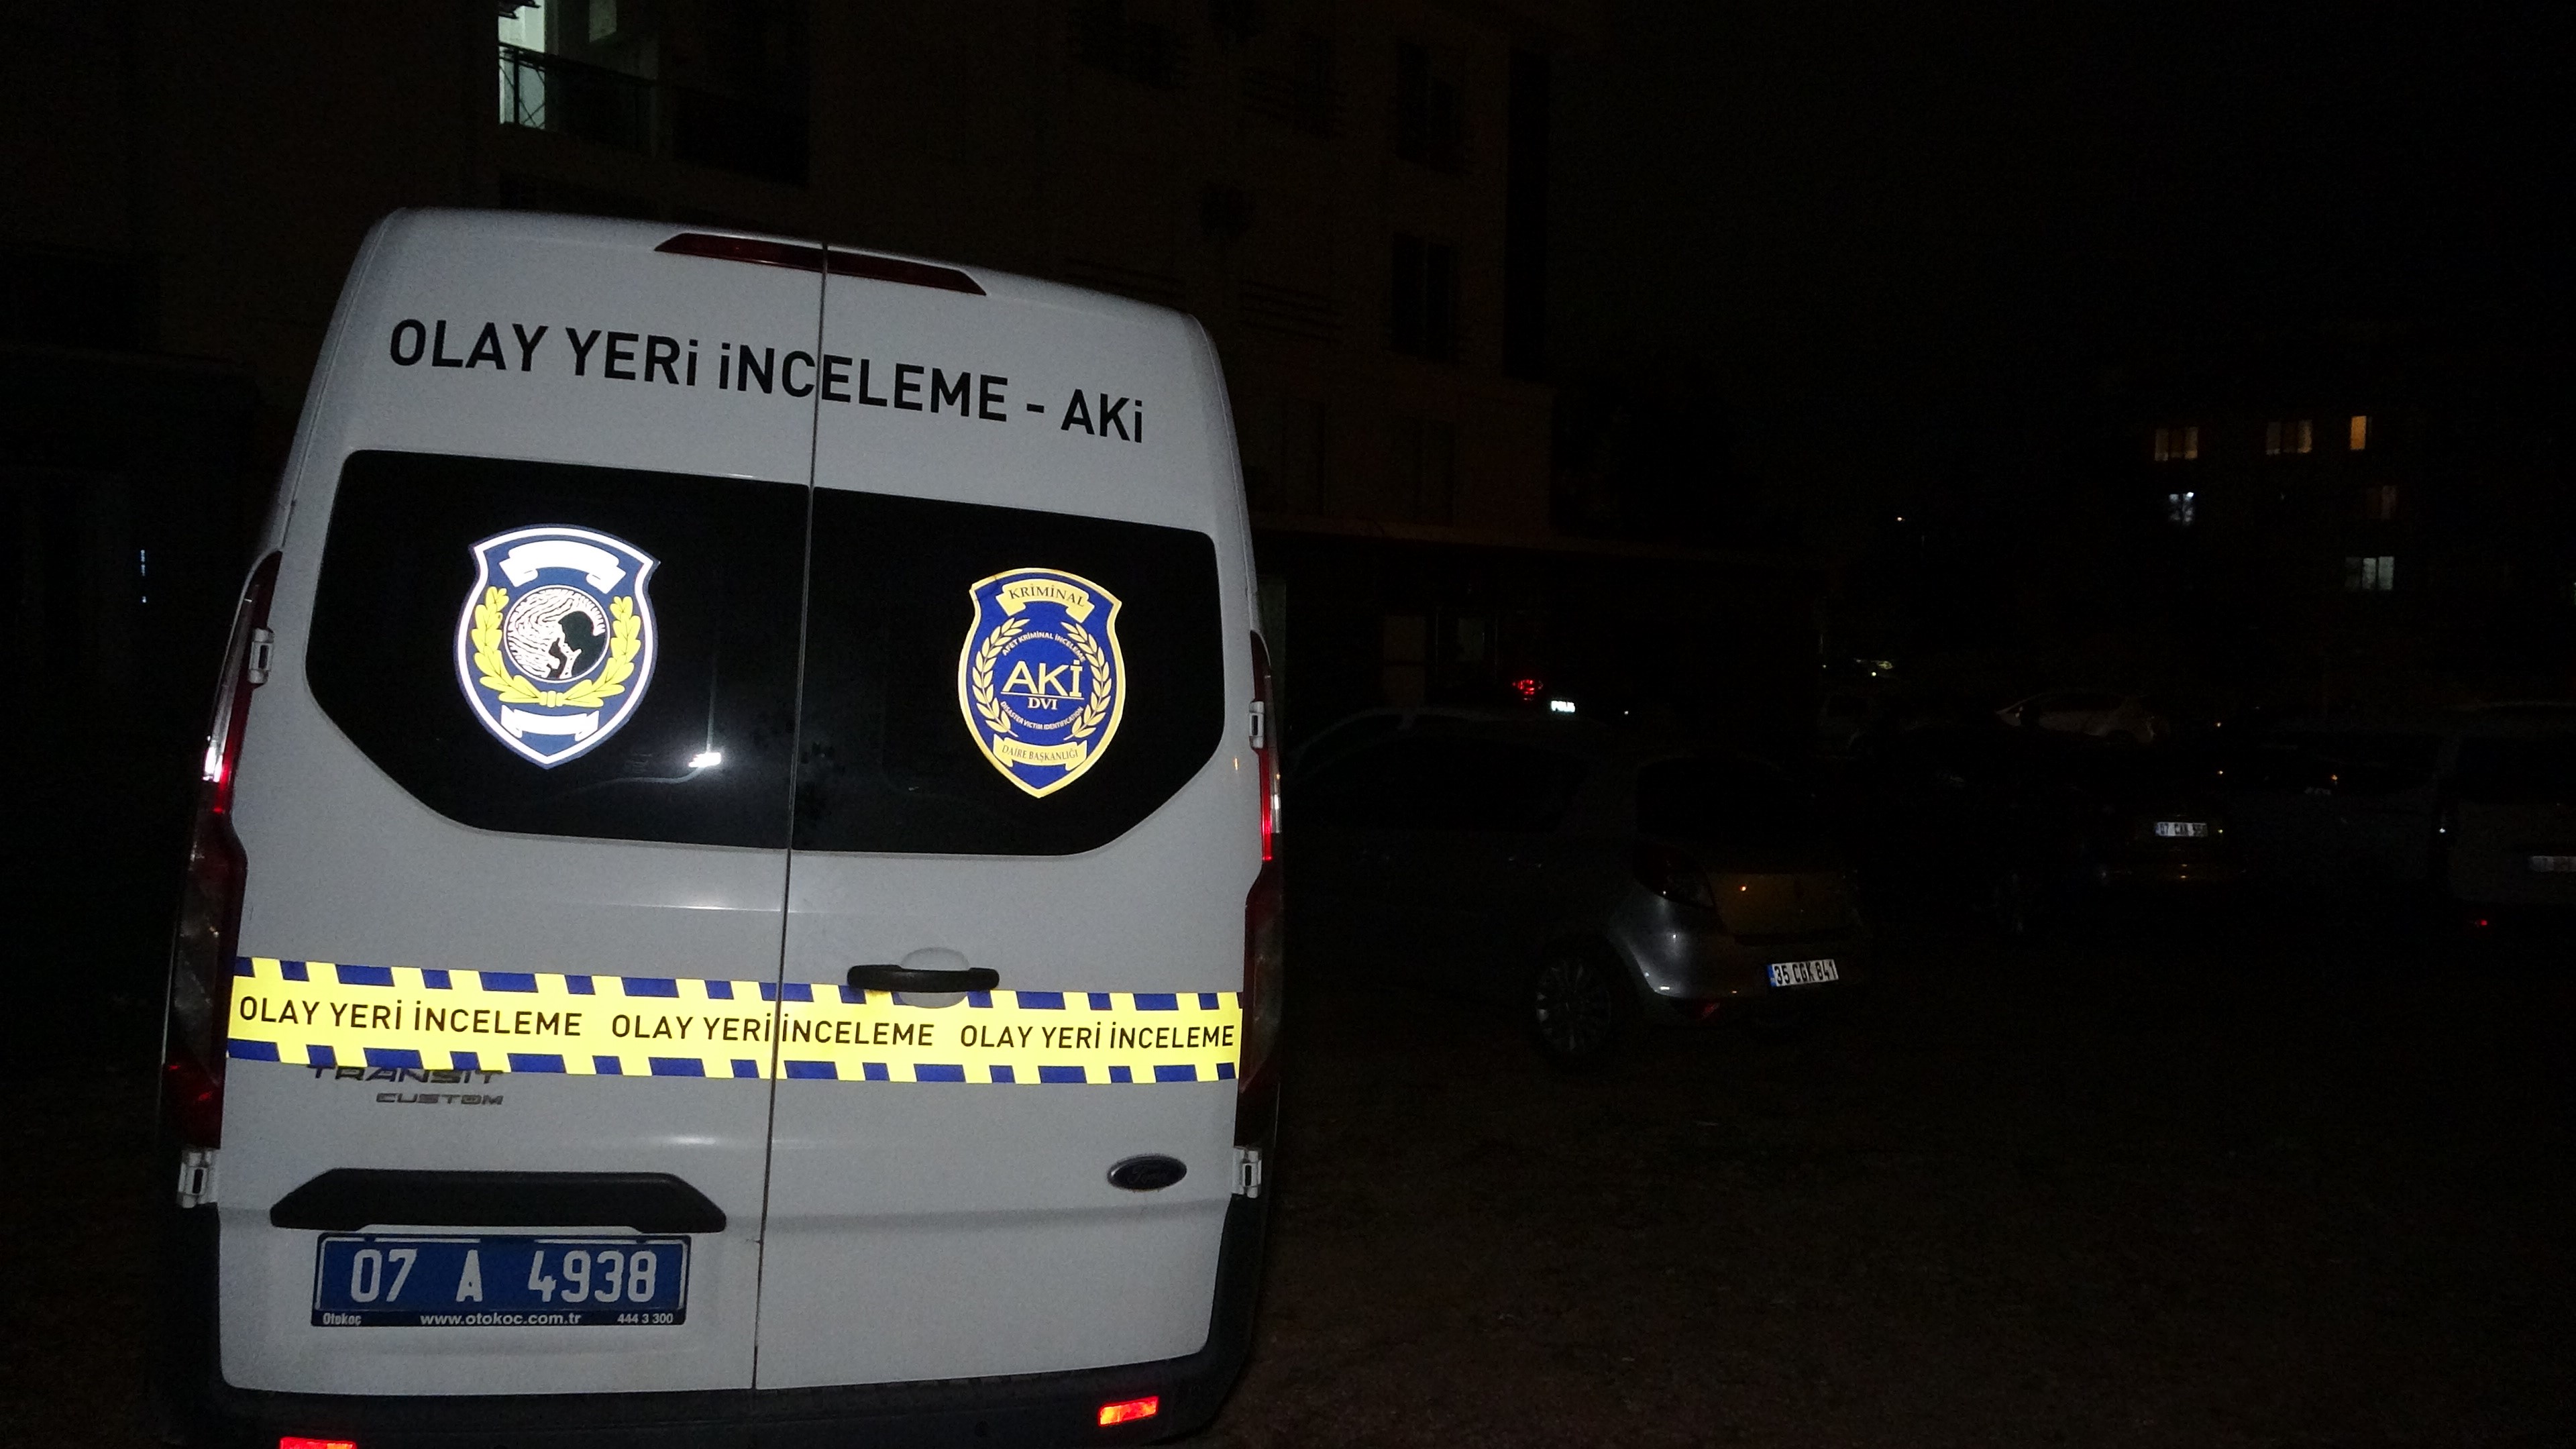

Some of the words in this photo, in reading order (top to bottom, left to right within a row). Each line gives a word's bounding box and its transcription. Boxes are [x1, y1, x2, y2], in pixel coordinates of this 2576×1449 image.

[390, 318, 549, 371] OLAY
[1002, 639, 1018, 656] AFET
[1027, 697, 1058, 710] DVI
[1000, 701, 1024, 725] DISASTER
[1023, 719, 1043, 730] VICTIM
[1774, 965, 1790, 985] 35
[239, 996, 320, 1026] OLAY
[612, 1014, 694, 1040] OLAY
[960, 1024, 1034, 1048] OLAY
[376, 1092, 504, 1106] CUSTOM
[351, 1248, 419, 1303] 07
[455, 1249, 484, 1303] A
[527, 1250, 657, 1303] 4938
[323, 1312, 362, 1327] Otokoç
[420, 1312, 582, 1326] www.otokoc.com.tr
[617, 1313, 639, 1324] 444
[641, 1313, 650, 1324] 3
[652, 1312, 674, 1324] 300
